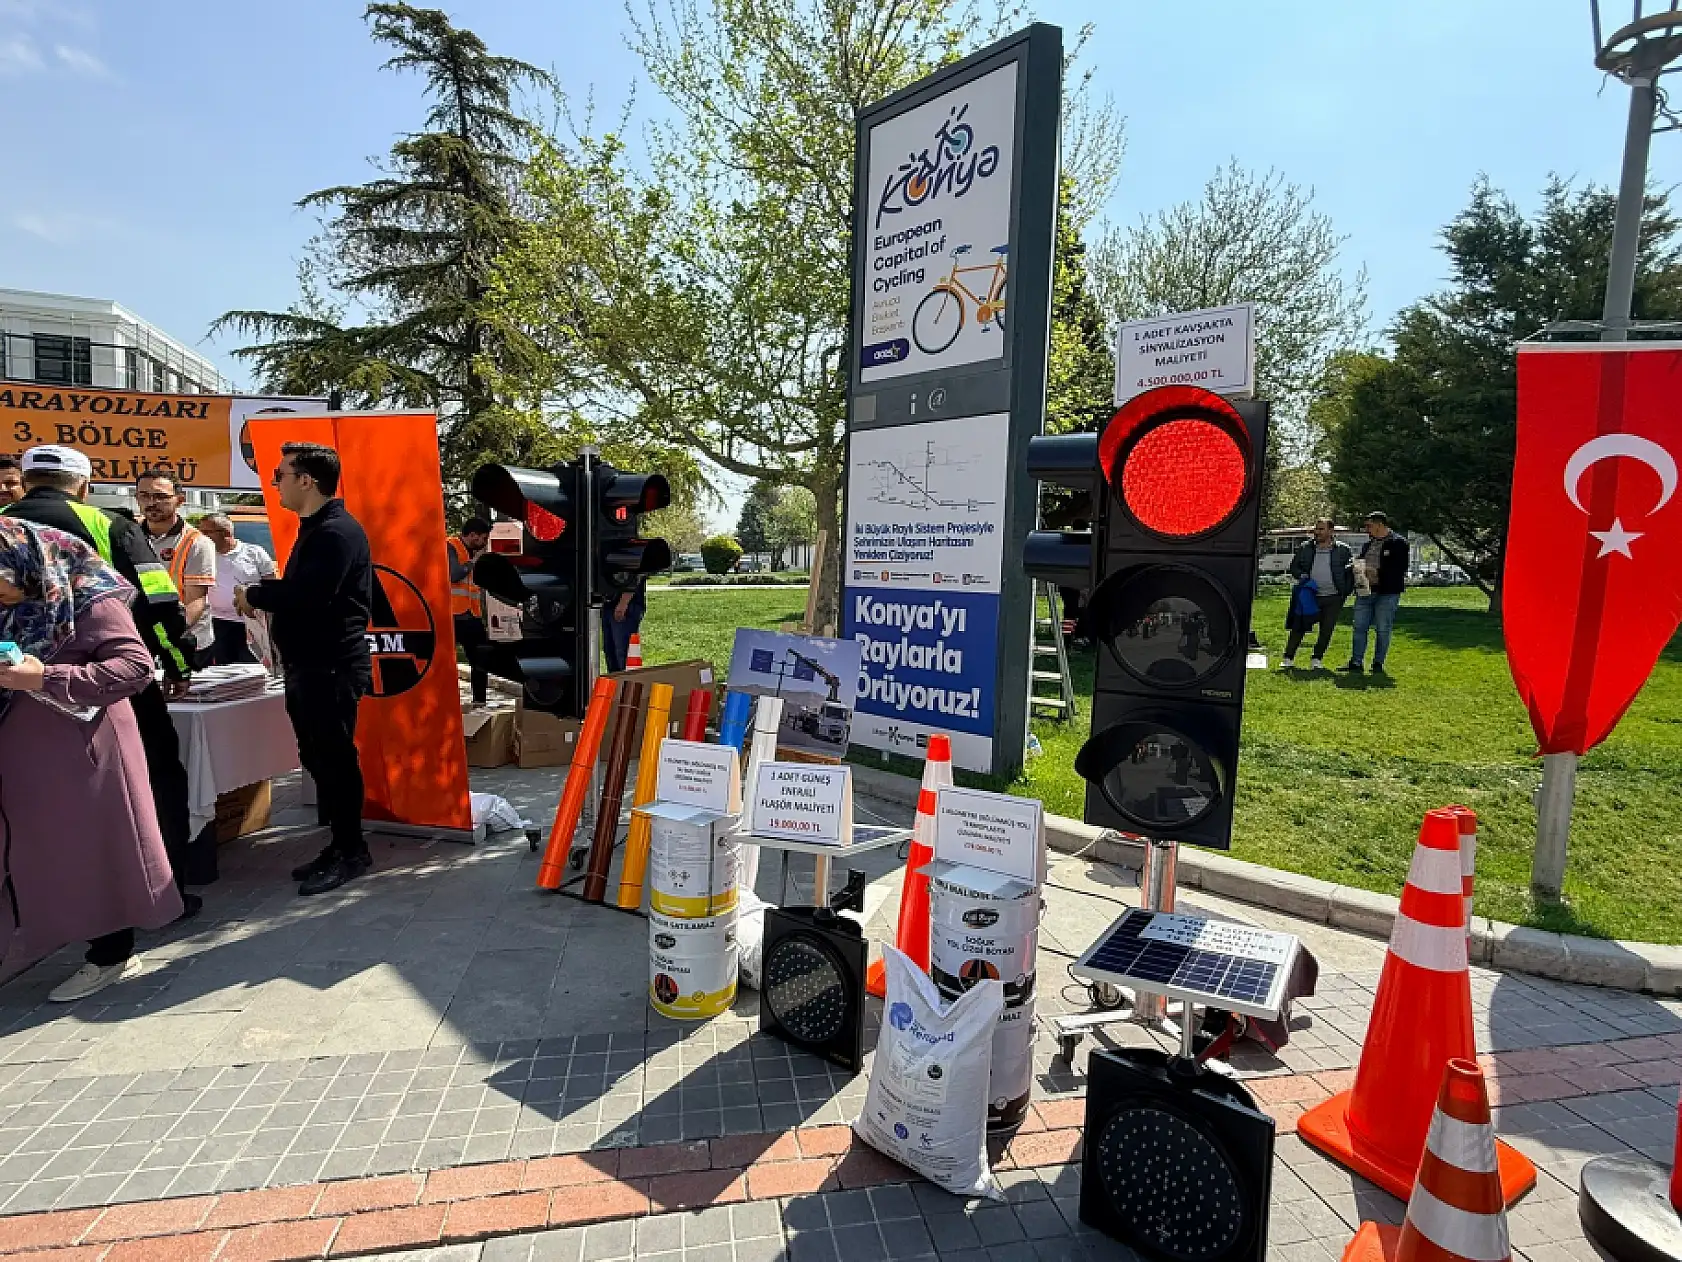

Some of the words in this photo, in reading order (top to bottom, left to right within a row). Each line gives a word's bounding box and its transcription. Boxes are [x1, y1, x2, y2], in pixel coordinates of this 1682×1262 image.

[874, 218, 942, 251] European
[873, 240, 928, 271] Capital
[930, 234, 947, 255] of
[873, 267, 925, 293] Cycling
[1139, 333, 1225, 355] SİNYALİZASYON
[1142, 327, 1172, 340] ADET
[1155, 350, 1209, 367] MALİYETİ
[1210, 369, 1225, 379] TL
[13, 420, 43, 442] 3.
[55, 420, 169, 449] BÖLGE
[855, 595, 967, 637] Konya'yı
[855, 632, 962, 674] Raylarla
[856, 664, 981, 719] Örüyoruz!
[776, 771, 799, 782] ADET
[801, 772, 831, 786] GÜNEŞ
[794, 800, 835, 814] MALİYETİ
[812, 823, 821, 832] TL
